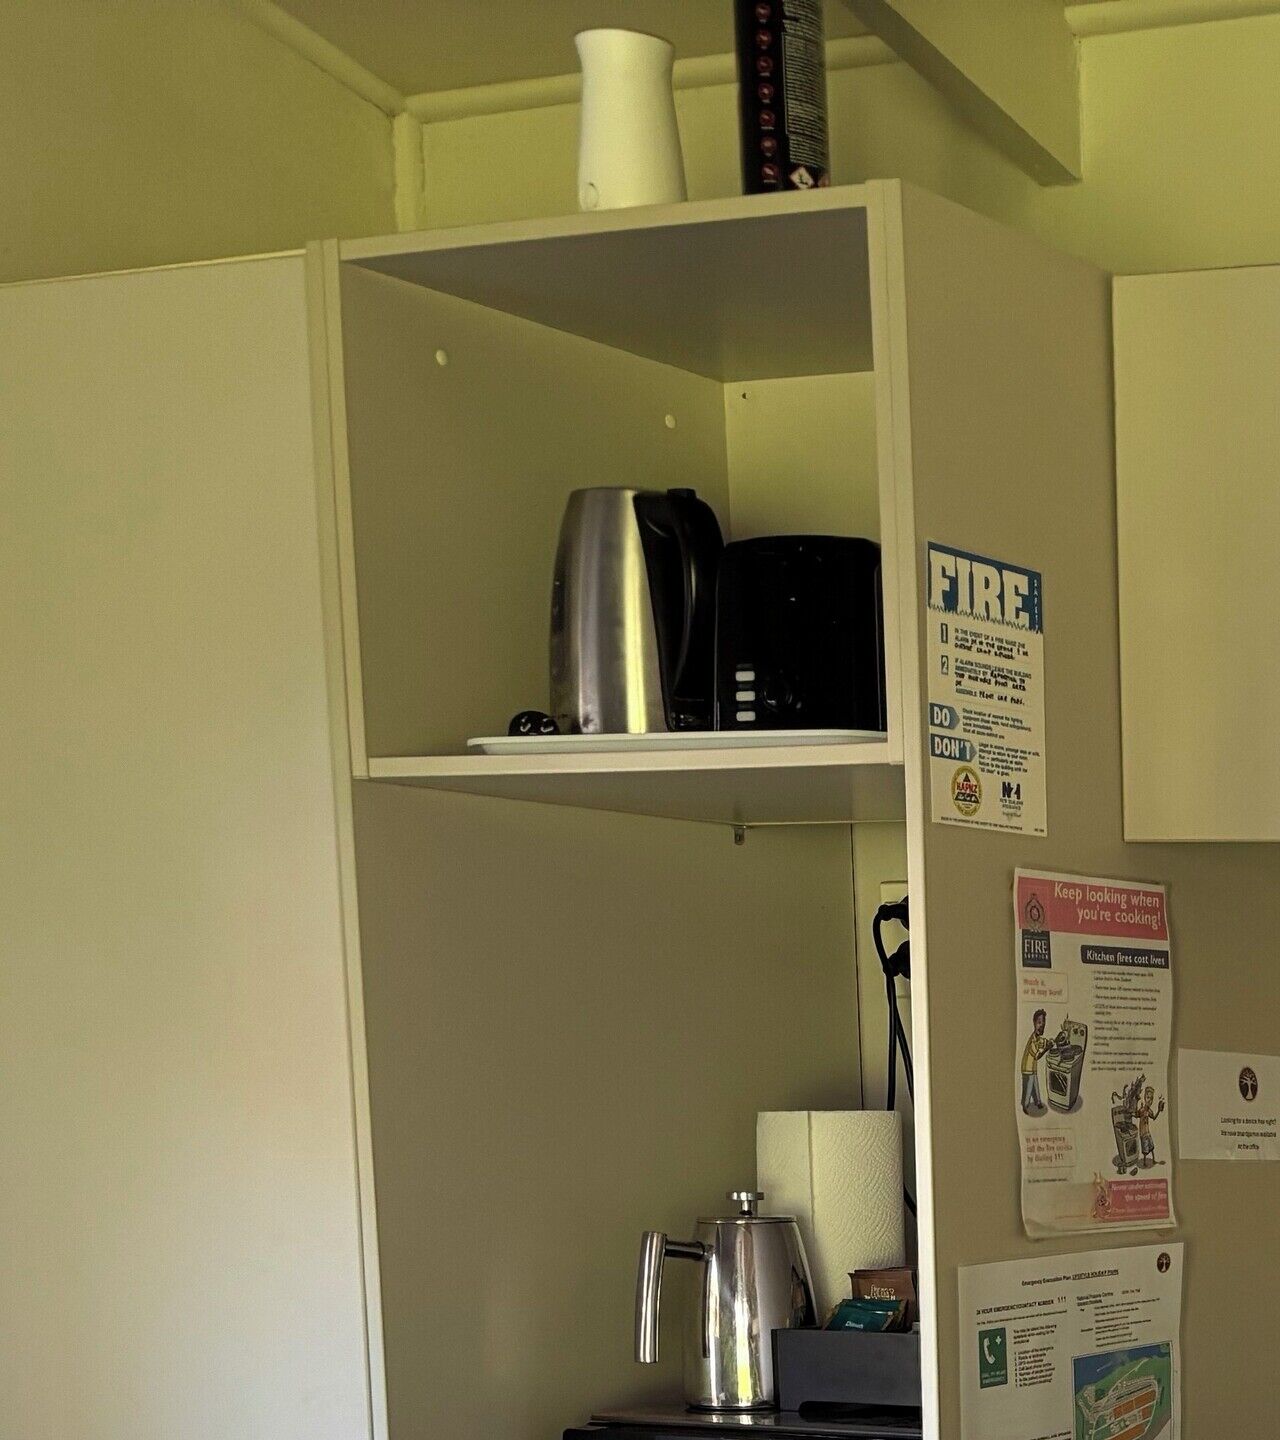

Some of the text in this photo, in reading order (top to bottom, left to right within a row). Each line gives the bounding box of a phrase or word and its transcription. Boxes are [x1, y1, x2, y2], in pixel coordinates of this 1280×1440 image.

[929, 549, 1030, 630] FIRE
[941, 655, 949, 675] 2
[933, 706, 950, 726] DO
[935, 737, 971, 760] DON'T
[1054, 883, 1159, 909] Keep looking when
[1077, 904, 1161, 930] you're cooking!
[1023, 938, 1048, 954] FIRE
[1086, 950, 1165, 966] Kitchen fires cost lives
[1021, 1277, 1042, 1287] Emergency
